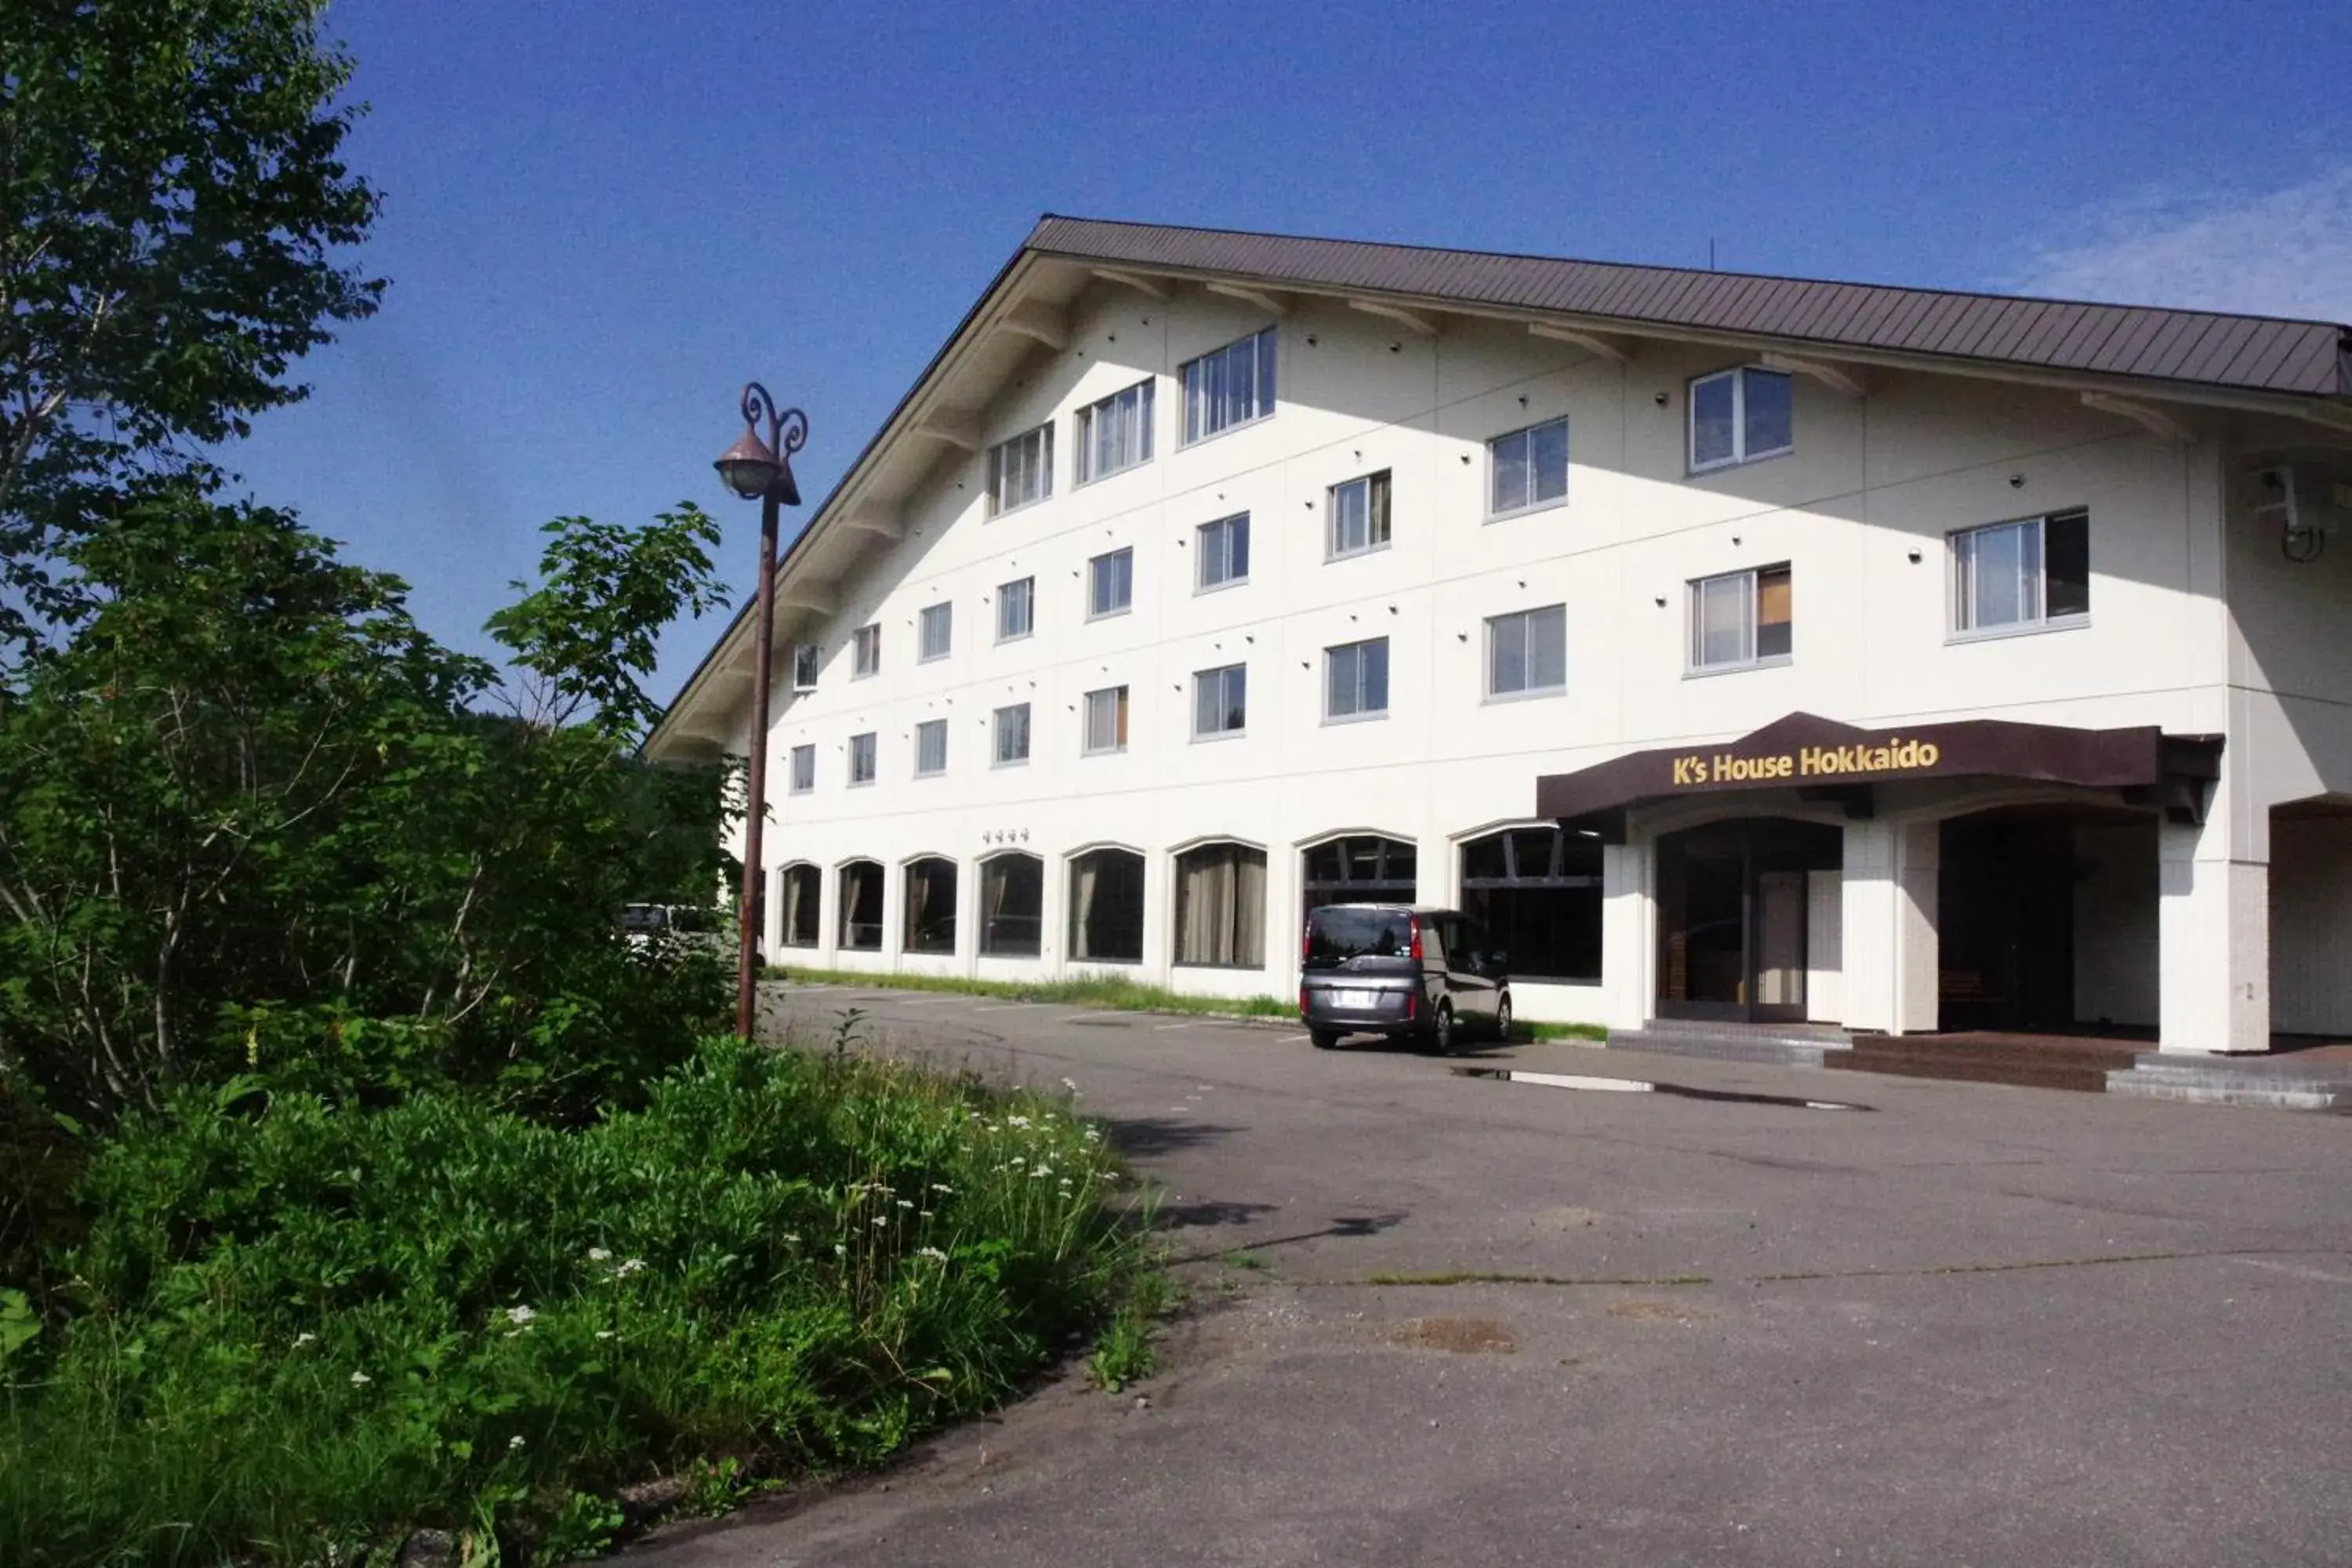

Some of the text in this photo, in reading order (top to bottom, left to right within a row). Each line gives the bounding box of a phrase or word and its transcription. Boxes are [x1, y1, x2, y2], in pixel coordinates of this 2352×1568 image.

[1673, 738, 1940, 784] K's House Hokkaido
